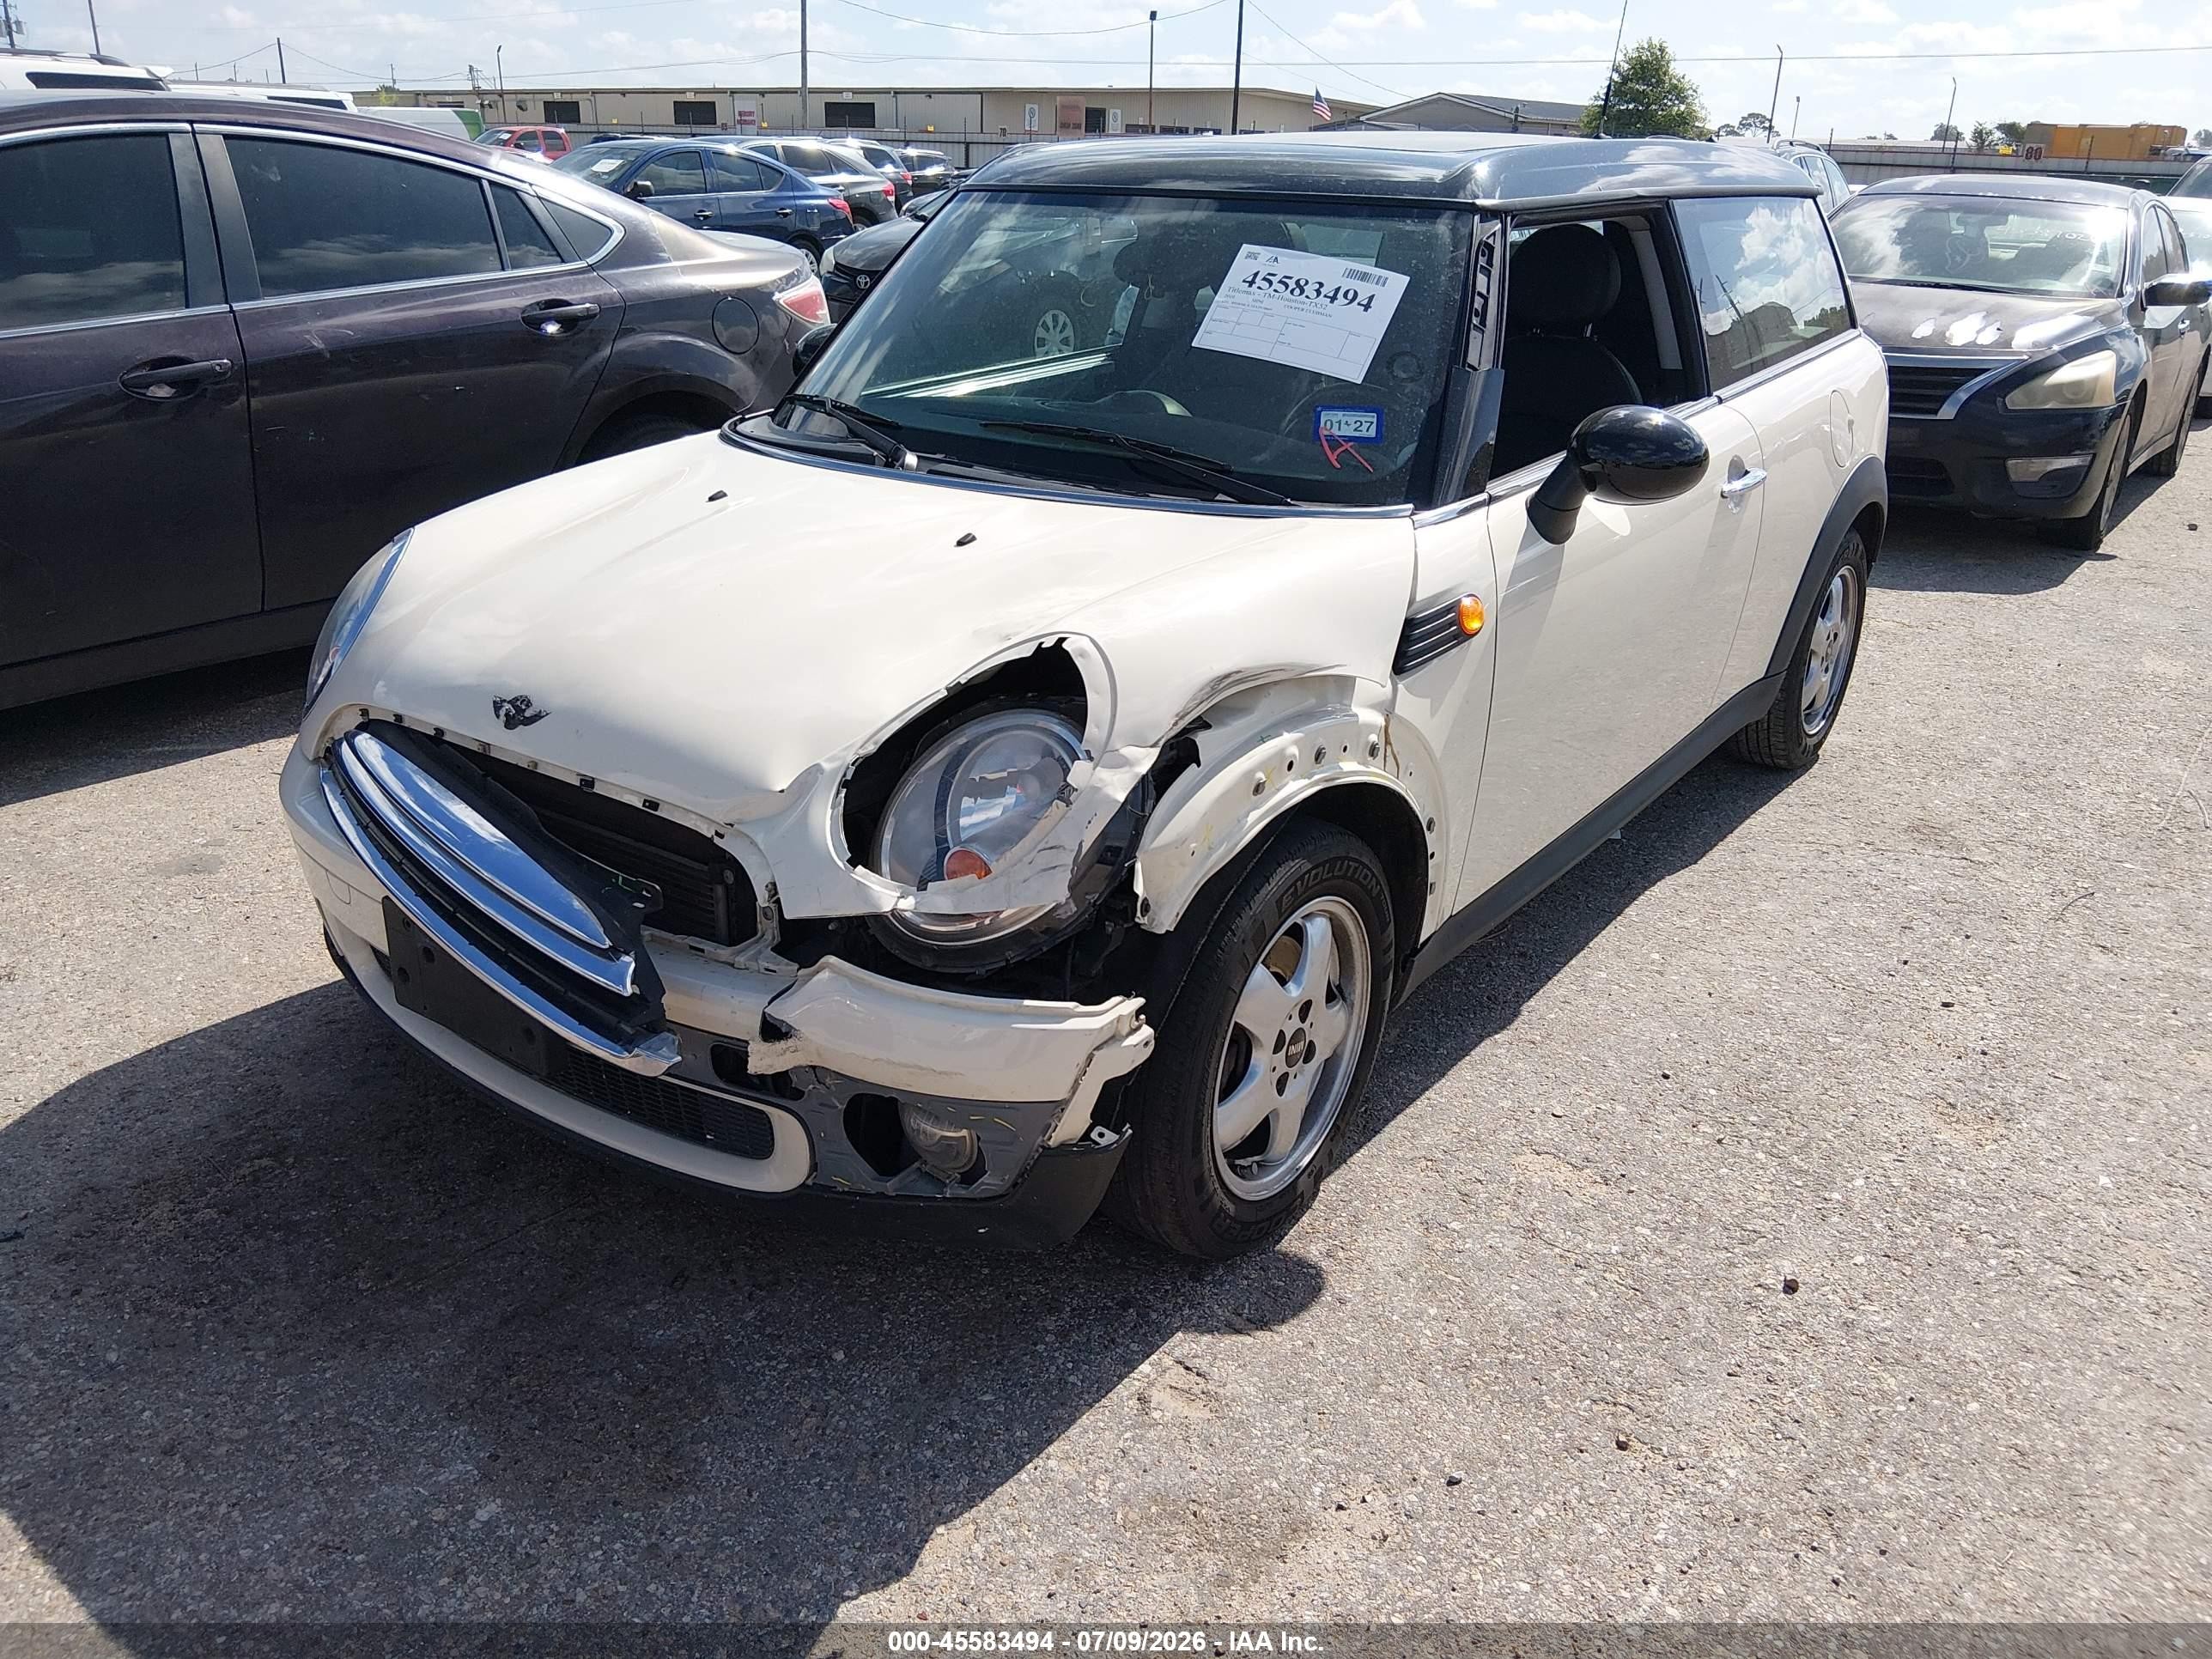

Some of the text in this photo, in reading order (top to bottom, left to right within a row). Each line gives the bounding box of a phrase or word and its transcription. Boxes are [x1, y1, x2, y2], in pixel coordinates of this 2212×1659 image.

[2025, 146, 2043, 161] 80
[1242, 270, 1376, 313] 45583494
[1352, 420, 1374, 433] 27
[1282, 860, 1381, 913] EVOLUTION
[1288, 1040, 1304, 1056] MINI
